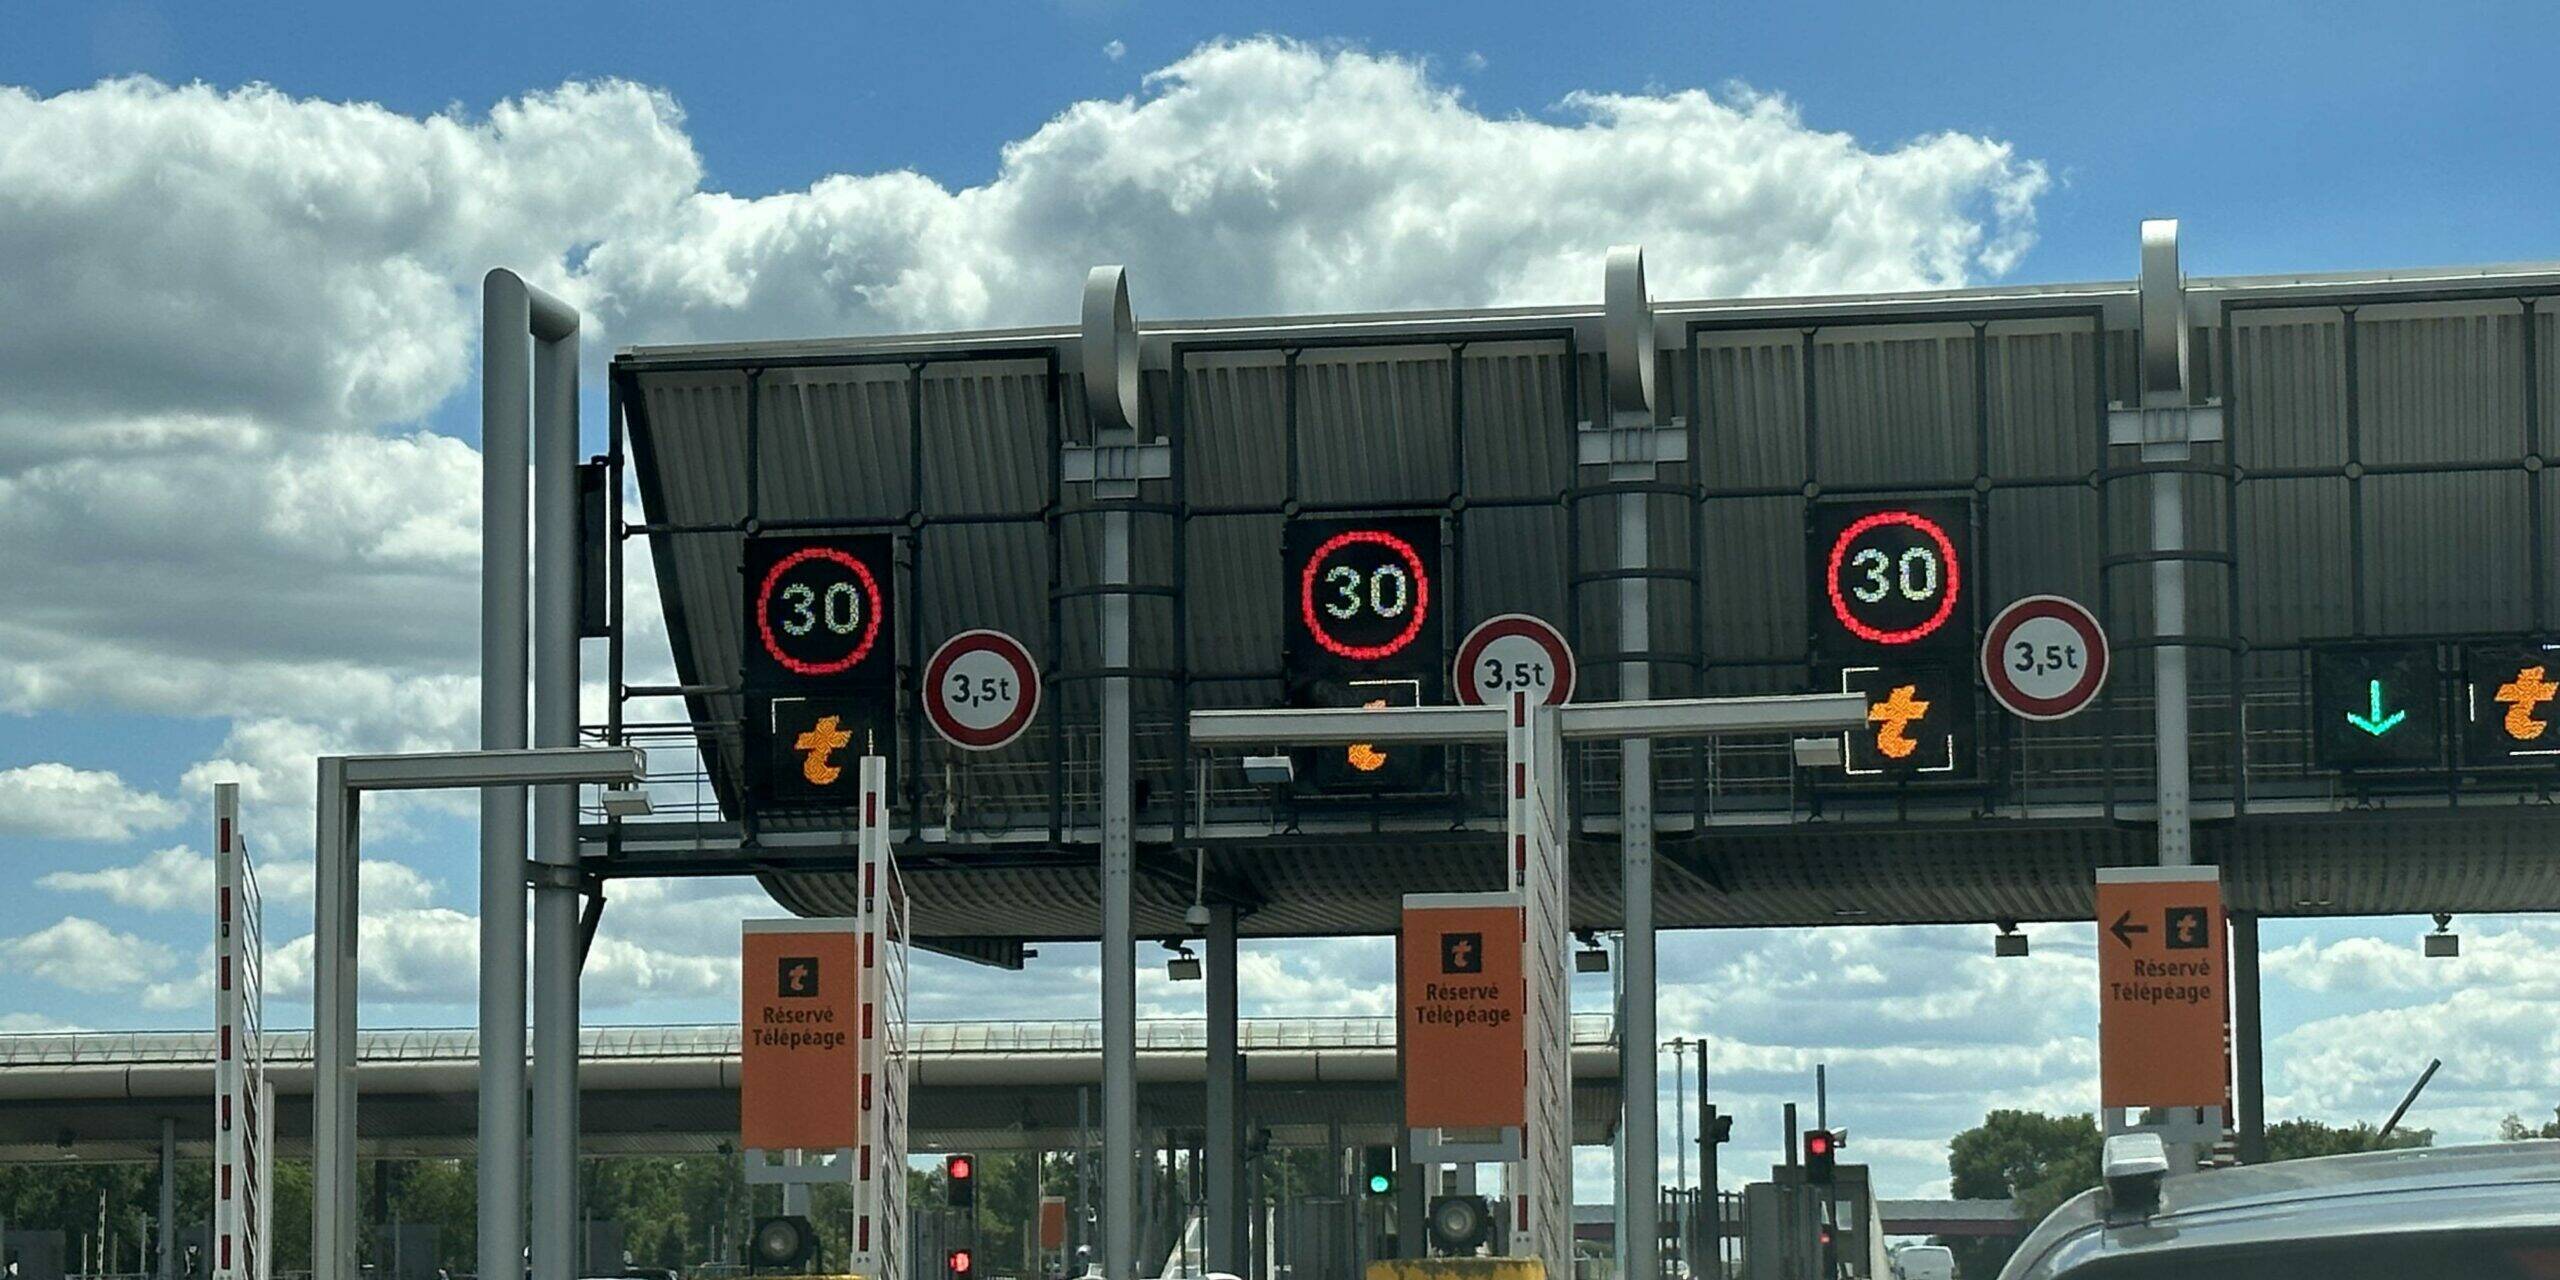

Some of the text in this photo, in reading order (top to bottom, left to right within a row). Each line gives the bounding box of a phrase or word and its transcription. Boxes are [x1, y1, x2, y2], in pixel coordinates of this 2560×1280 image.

[1852, 546, 1937, 603] 30
[1325, 564, 1407, 618] 30
[782, 582, 860, 635] 30
[2014, 641, 2078, 676] 3,5t
[1483, 659, 1546, 692] 3,5t
[951, 674, 1011, 708] 3,5t
[2134, 958, 2210, 977] Réservé
[1426, 983, 1499, 1000] Réservé
[2112, 981, 2211, 1005] Télépéage
[763, 1006, 834, 1024] Réservé
[1416, 1005, 1512, 1028] Télépéage
[752, 1028, 846, 1050] Télépéage
